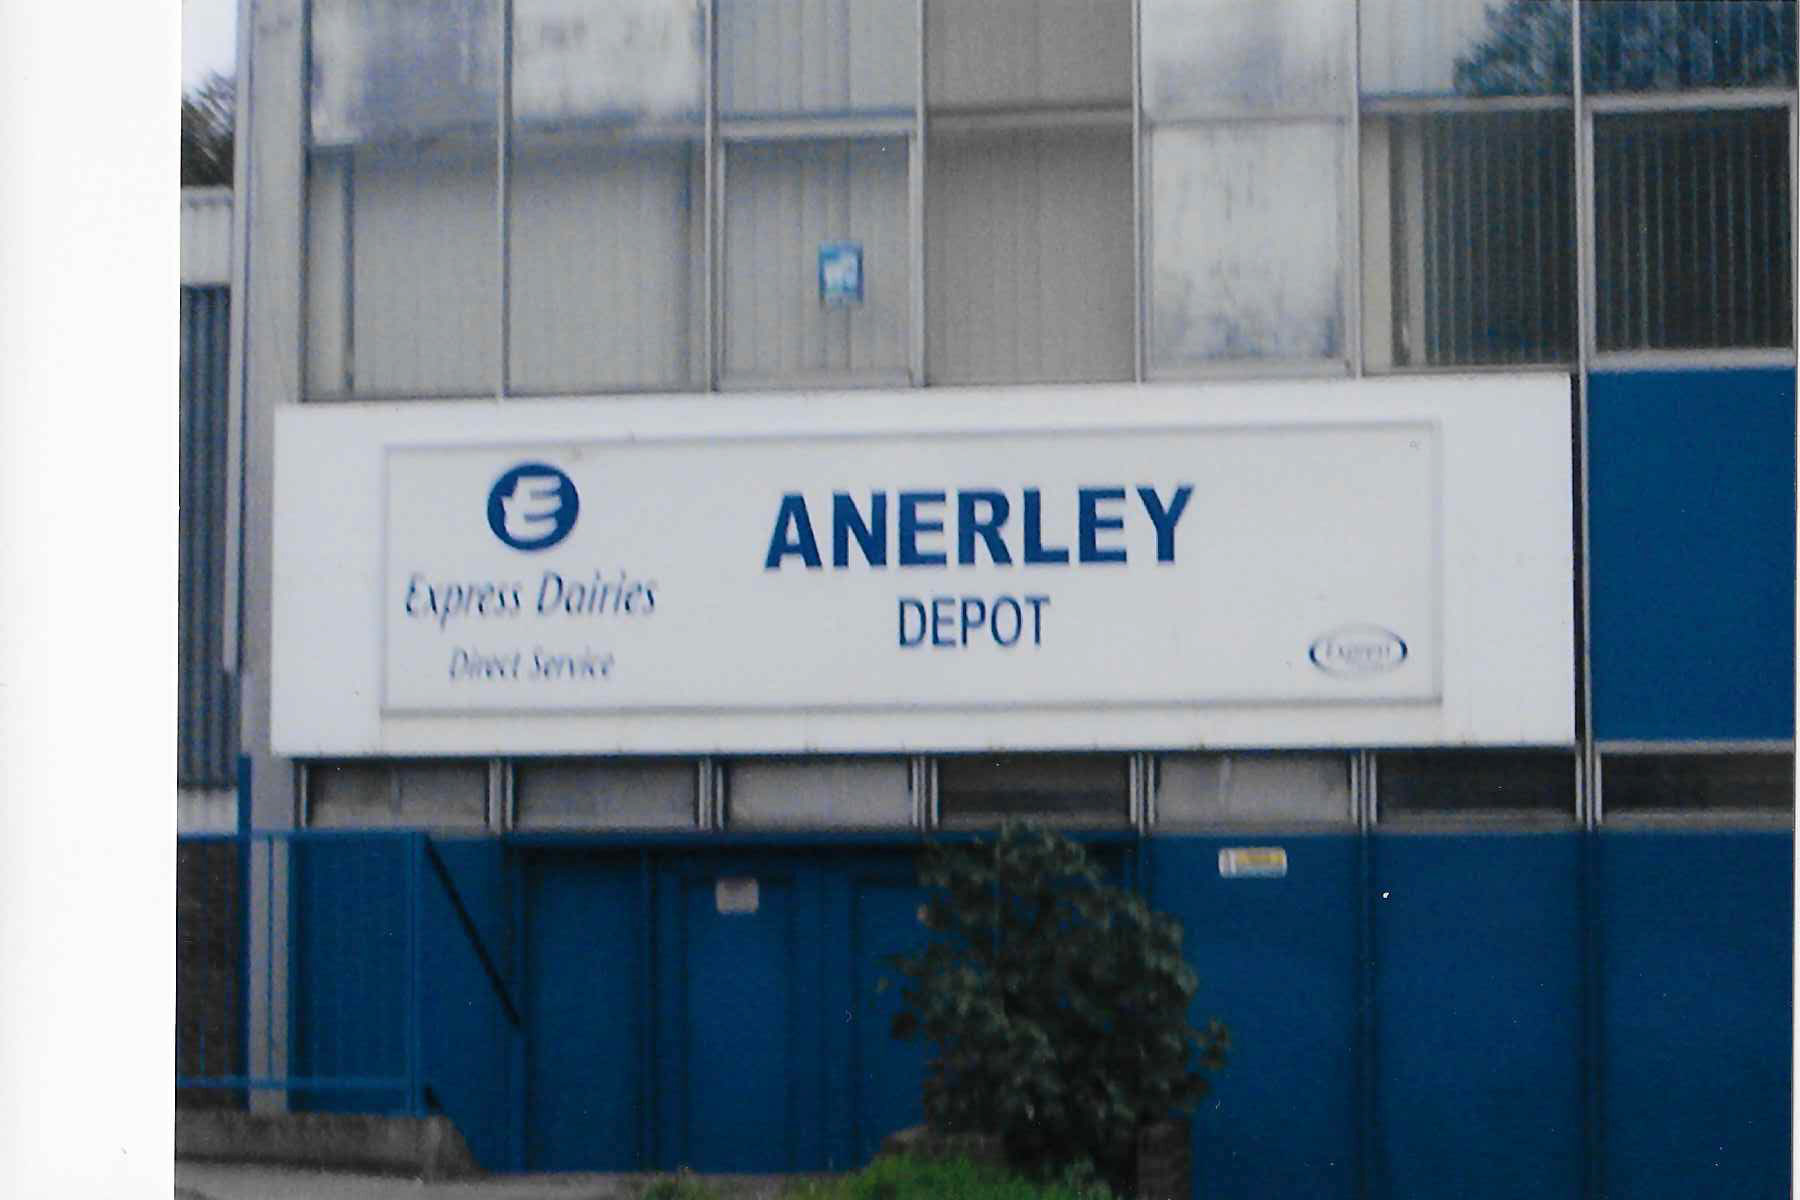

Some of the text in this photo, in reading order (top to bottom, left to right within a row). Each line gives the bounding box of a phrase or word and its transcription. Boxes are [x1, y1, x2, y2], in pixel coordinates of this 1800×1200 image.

[764, 484, 1195, 569] ANERLEY
[404, 569, 658, 632] Express Dairies
[898, 595, 1051, 648] DEPOT
[449, 645, 616, 682] Direct Service
